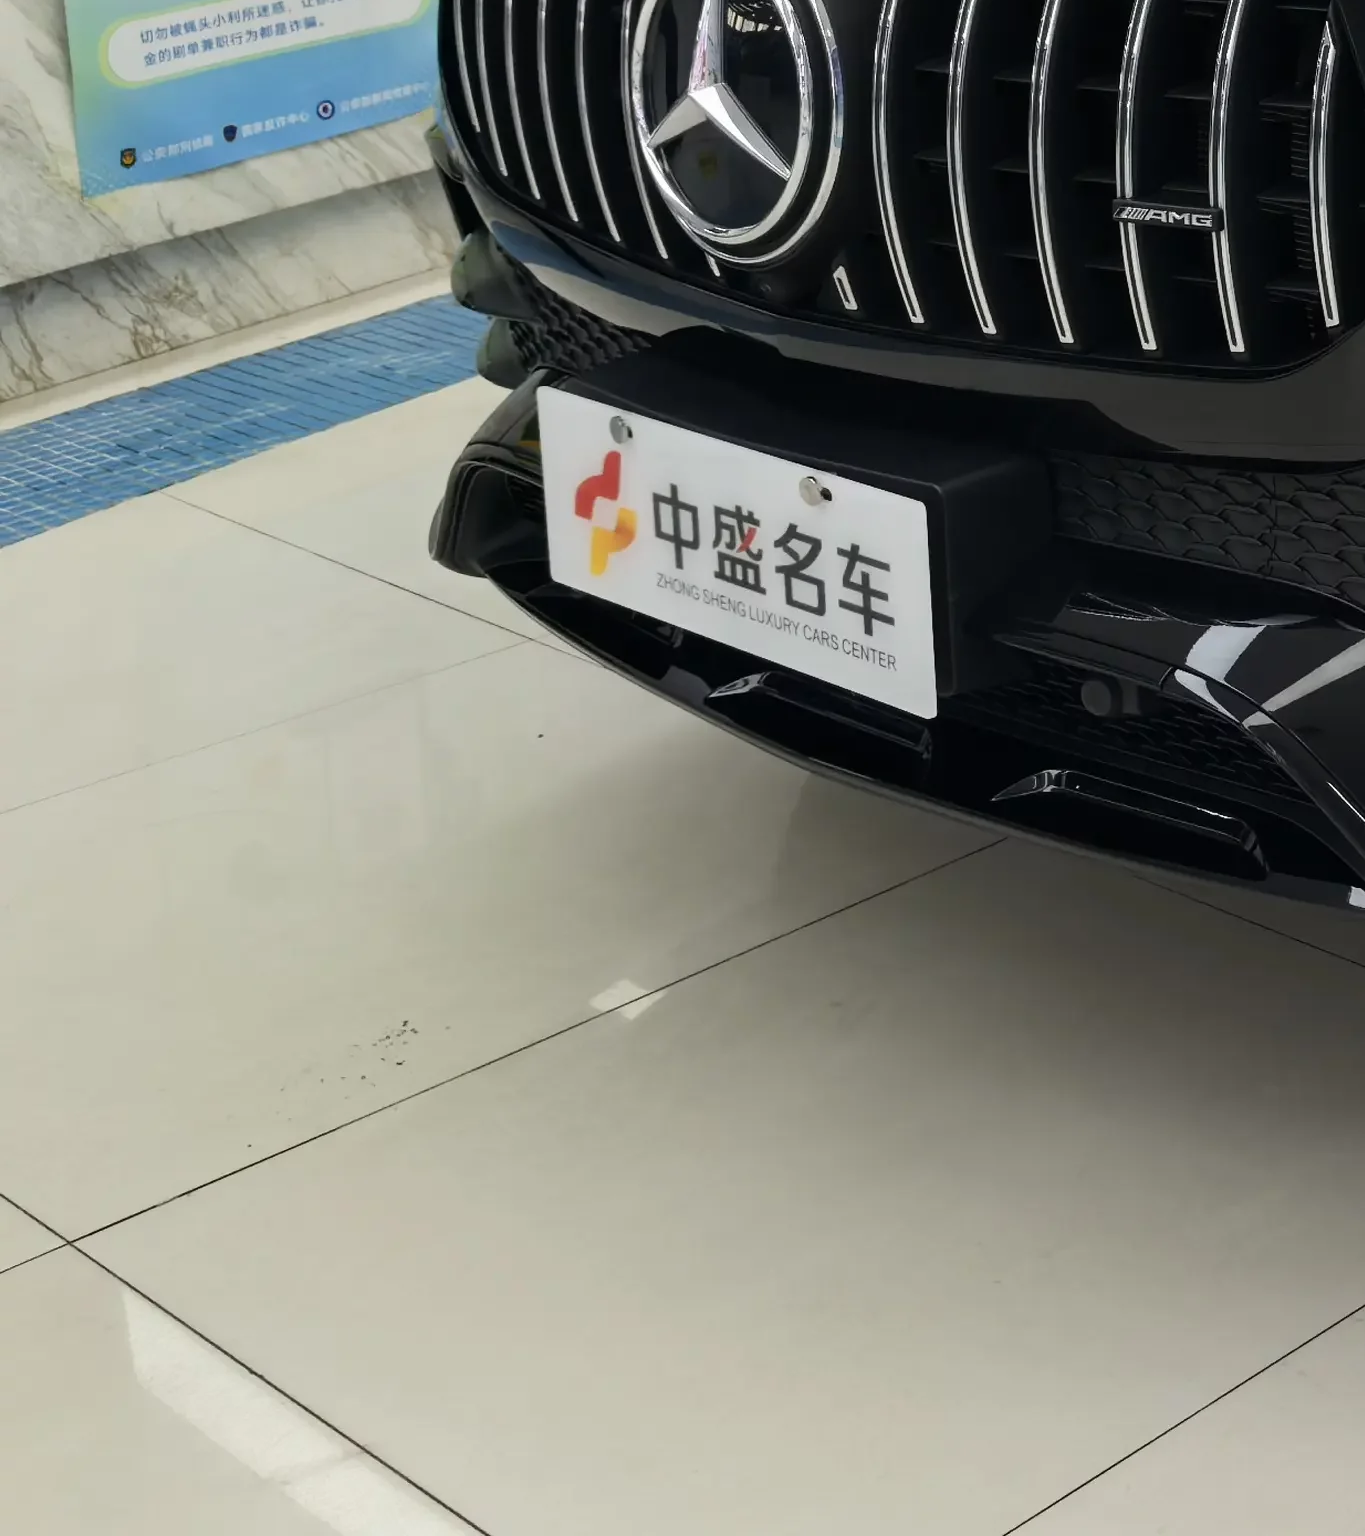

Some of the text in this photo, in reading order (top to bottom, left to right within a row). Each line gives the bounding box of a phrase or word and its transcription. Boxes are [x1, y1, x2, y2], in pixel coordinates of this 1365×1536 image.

[1145, 208, 1214, 228] AMG
[652, 483, 896, 637] 中盛名车
[656, 572, 898, 672] ZHONG SHENG LUXURY CARS CENTER
